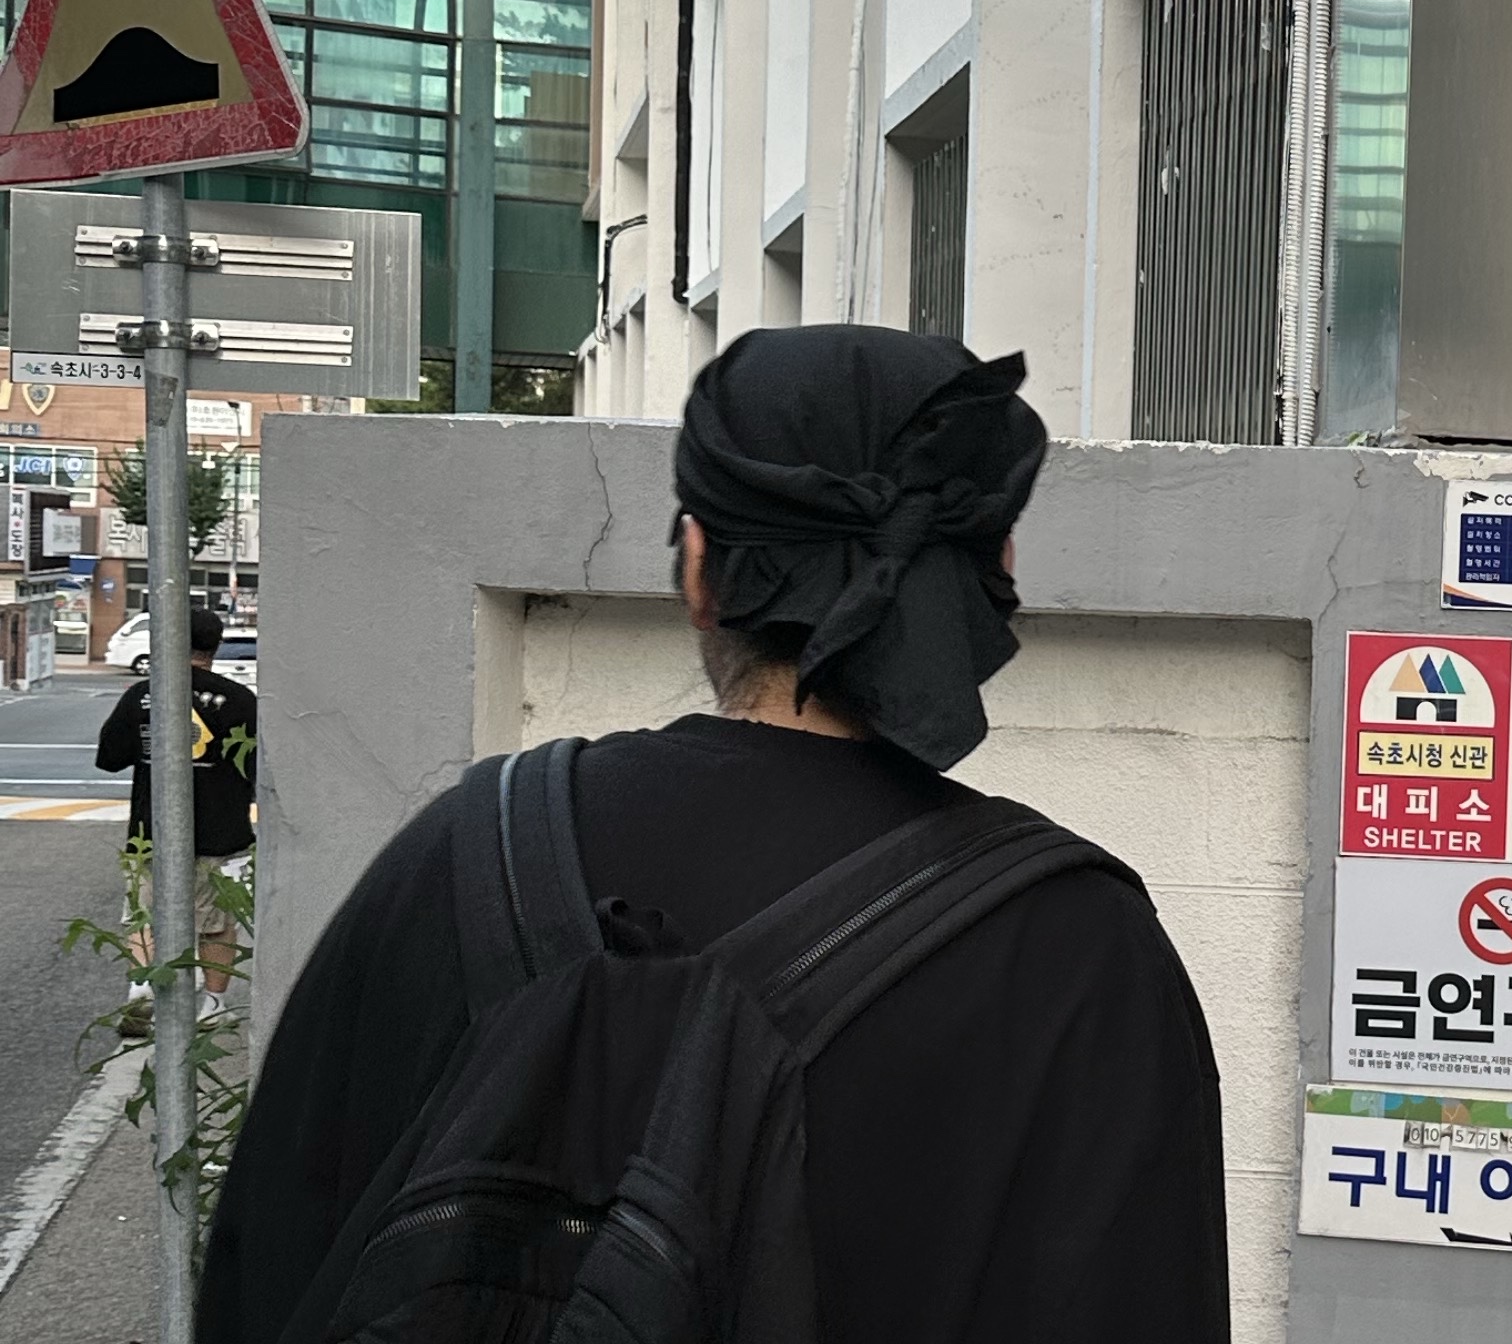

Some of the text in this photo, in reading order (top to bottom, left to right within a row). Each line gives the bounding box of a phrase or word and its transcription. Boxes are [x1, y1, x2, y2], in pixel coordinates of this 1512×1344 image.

[1366, 740, 1488, 770] 속초시청 신관
[1364, 826, 1482, 853] SHELTER
[1328, 1146, 1451, 1215] 구내
